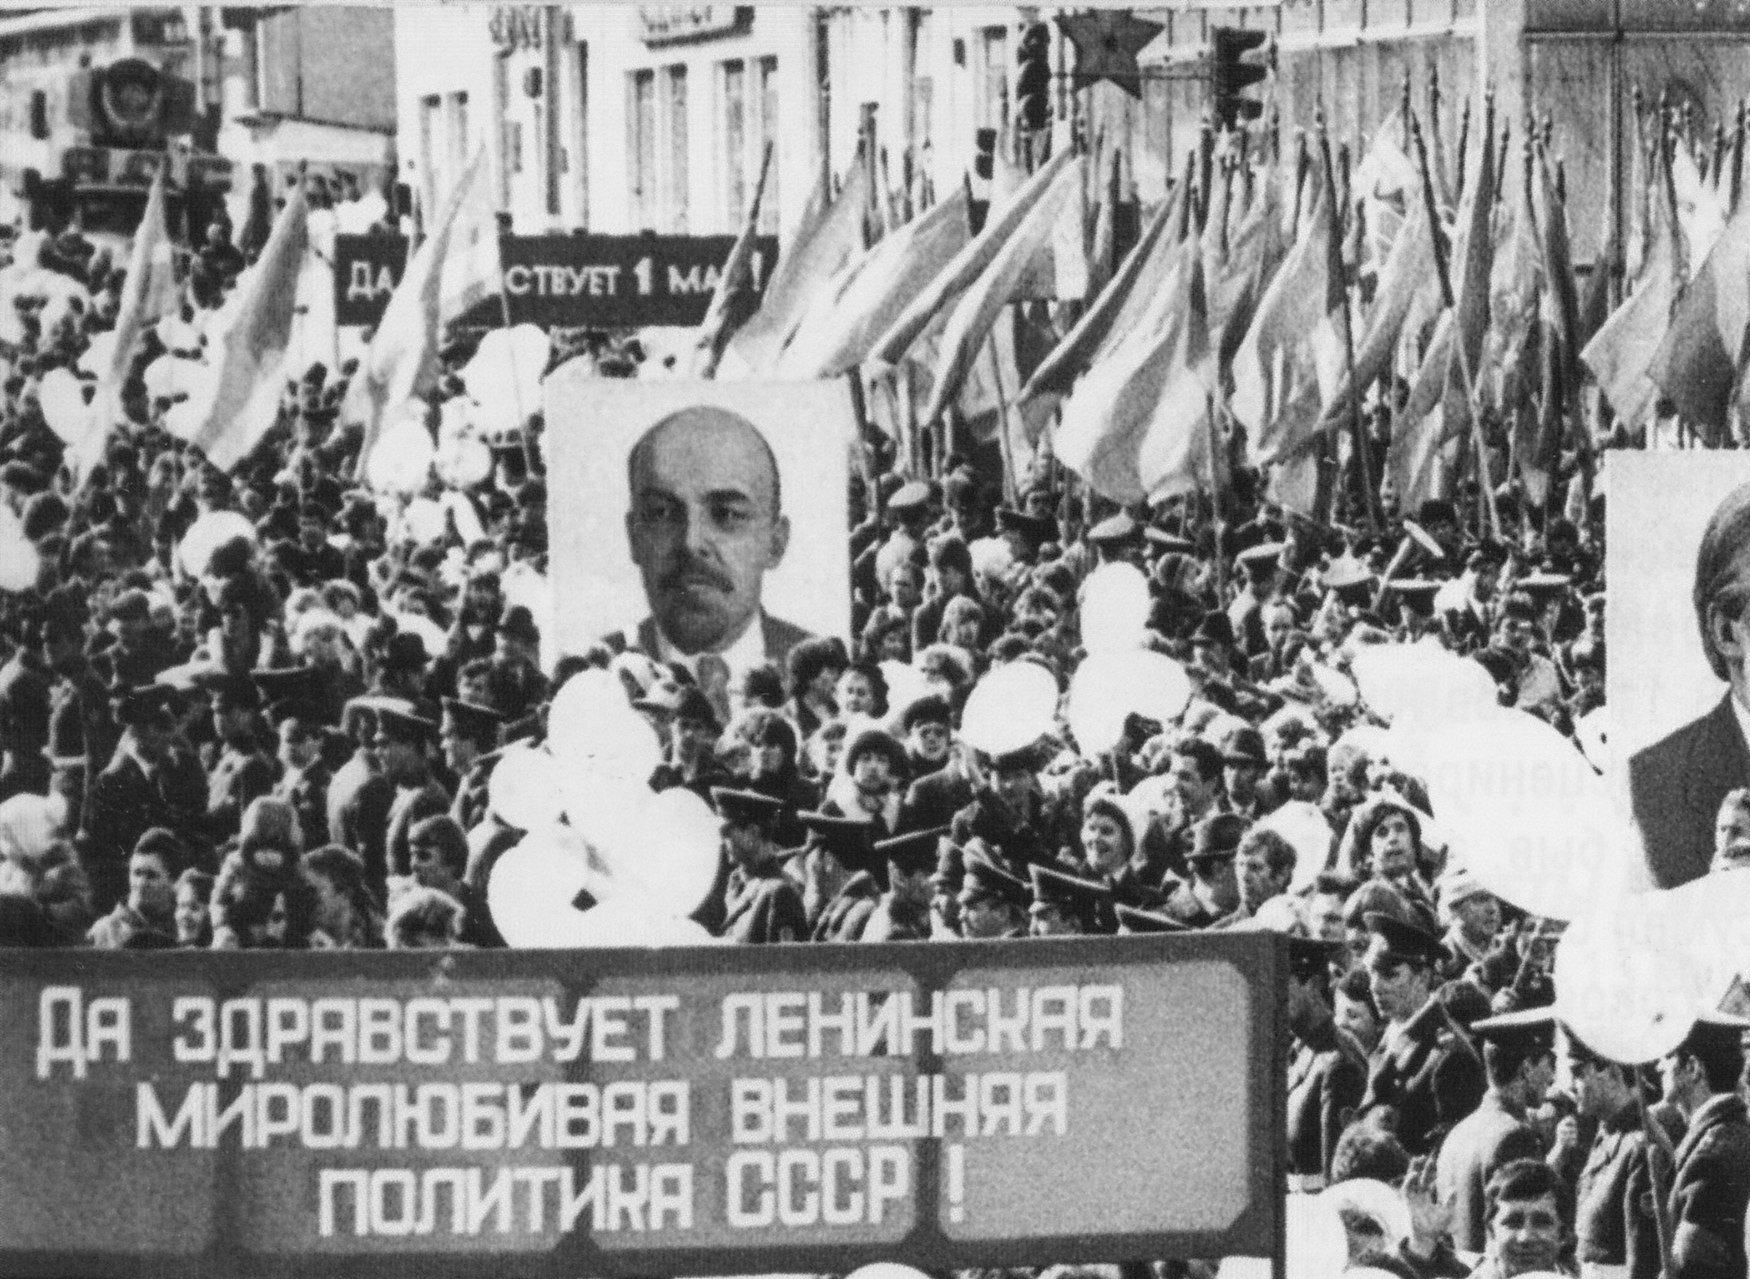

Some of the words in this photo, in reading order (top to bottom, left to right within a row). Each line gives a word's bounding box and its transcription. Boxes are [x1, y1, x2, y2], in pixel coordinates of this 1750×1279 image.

[348, 260, 394, 301] ДА
[504, 264, 621, 296] СТВУЕТ
[633, 256, 652, 295] 1
[171, 994, 681, 1080] ЗДРАВСТВУЕТ
[714, 984, 1126, 1061] ЛЕНИНСКАЯ
[136, 1079, 692, 1149] МИРОЛЮБИВАЯ
[730, 1070, 1069, 1144] ВНЕШНЯЯ
[318, 1162, 695, 1238] ПОЛИТИКА
[725, 1145, 911, 1228] СССР
